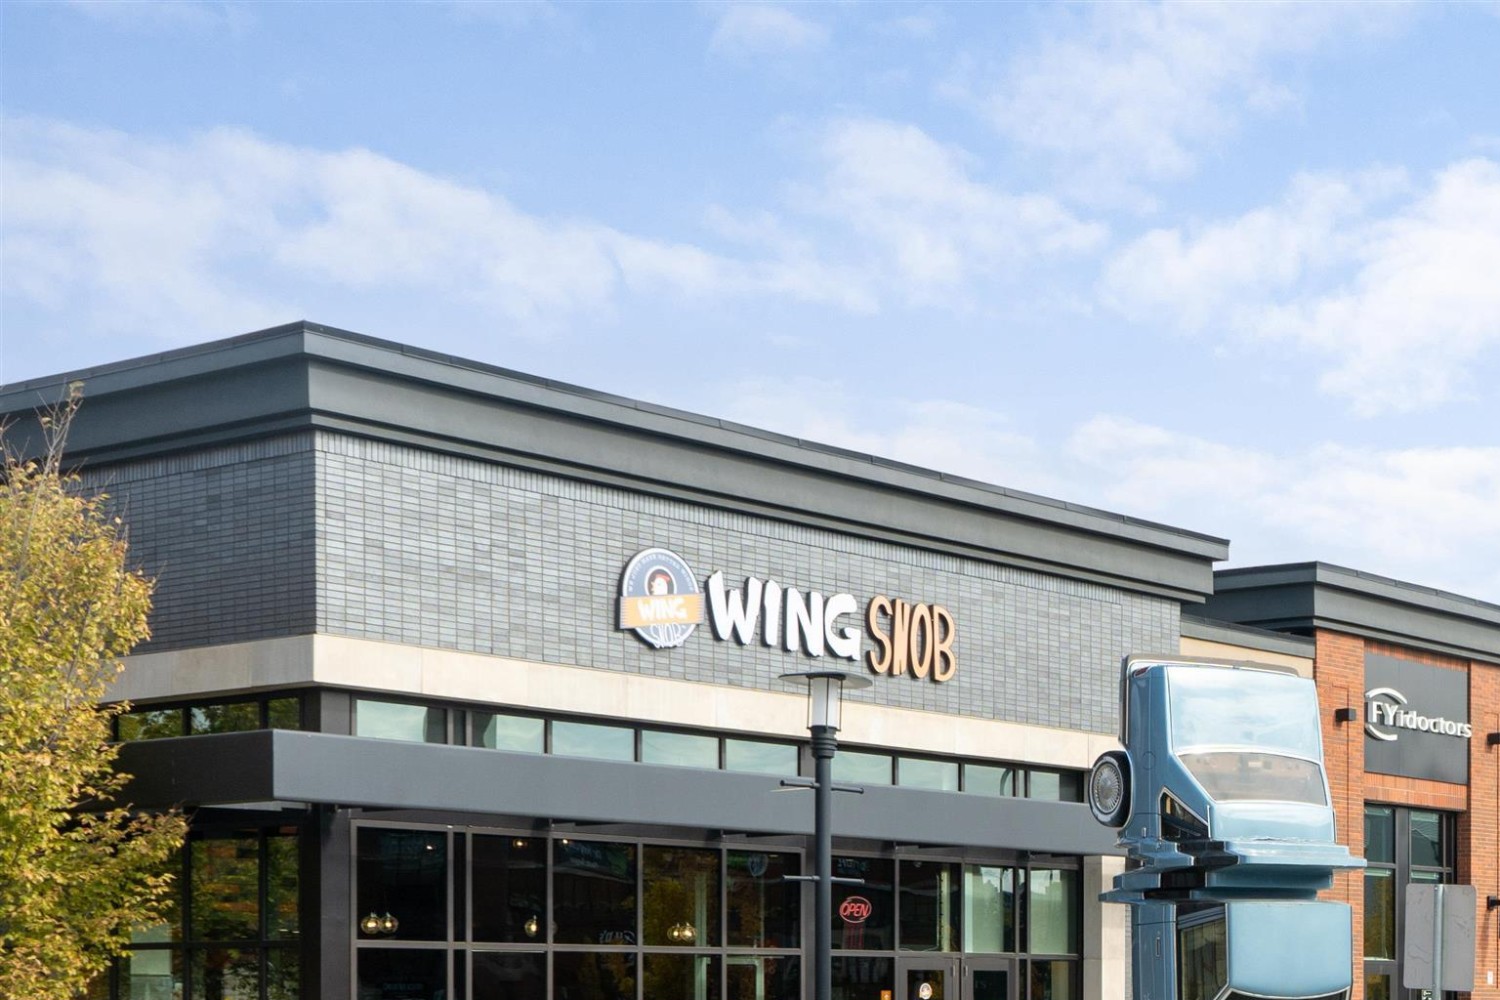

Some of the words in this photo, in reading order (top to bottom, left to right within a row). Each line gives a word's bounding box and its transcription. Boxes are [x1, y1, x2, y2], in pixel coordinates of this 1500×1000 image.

[637, 598, 687, 621] WING
[706, 570, 861, 661] WING
[867, 595, 957, 683] SNOB
[1368, 701, 1473, 738] FYidoctors
[840, 902, 869, 917] OPEN
